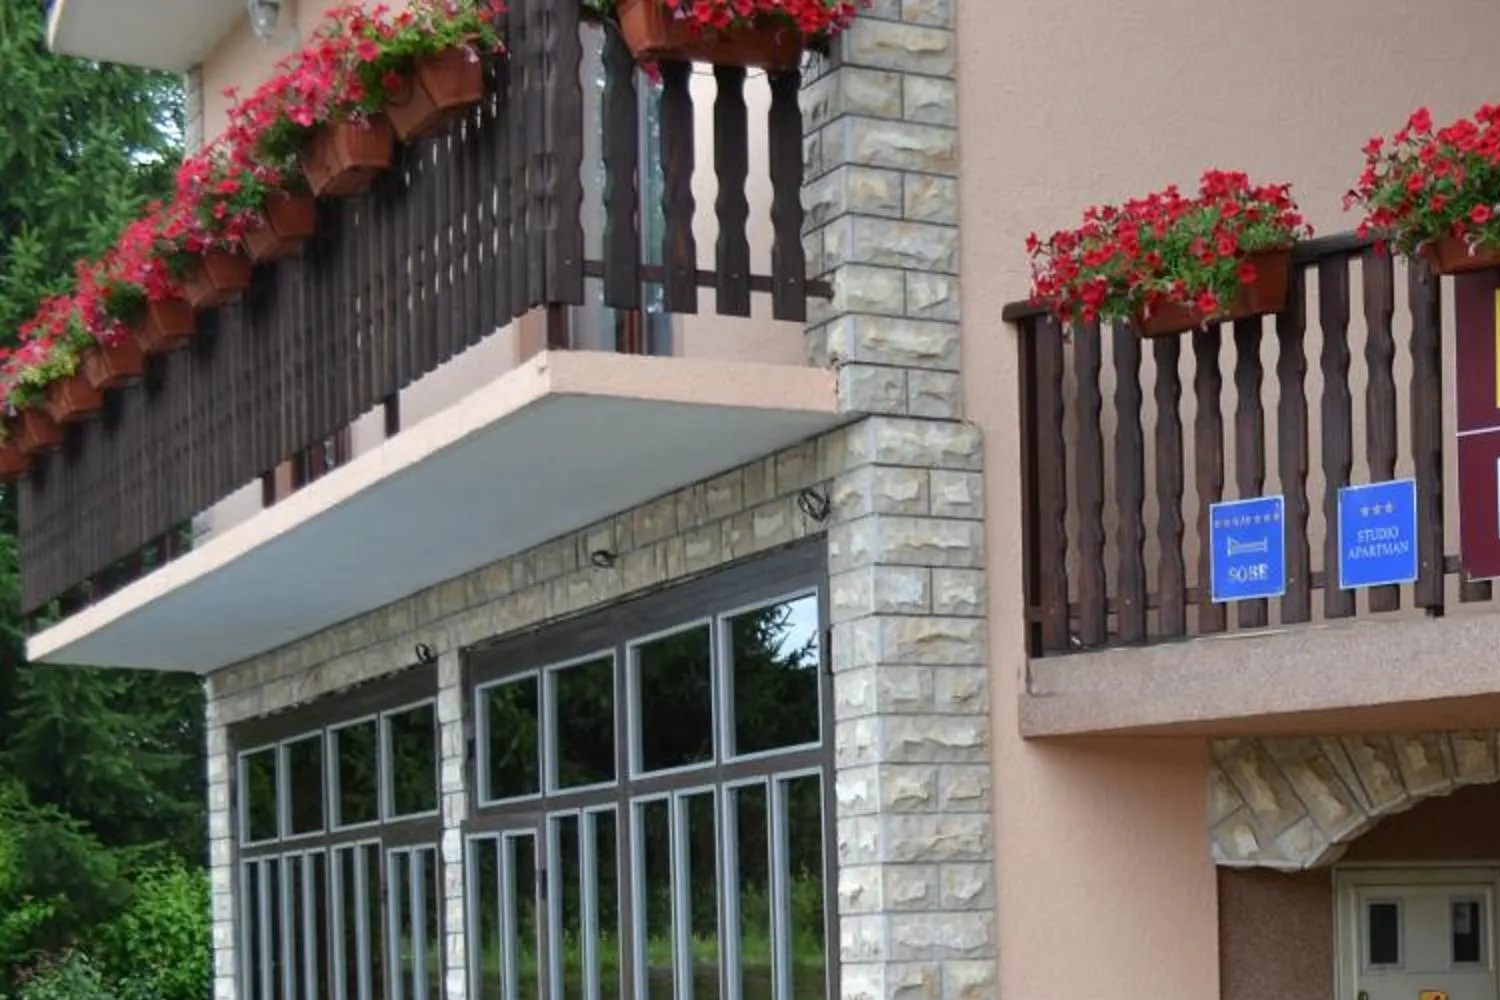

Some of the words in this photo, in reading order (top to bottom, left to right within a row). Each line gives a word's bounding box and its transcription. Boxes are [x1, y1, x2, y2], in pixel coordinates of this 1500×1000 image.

[1356, 526, 1400, 545] STUDIO
[1347, 539, 1410, 560] APARTMAN
[1227, 562, 1269, 583] SOBE
